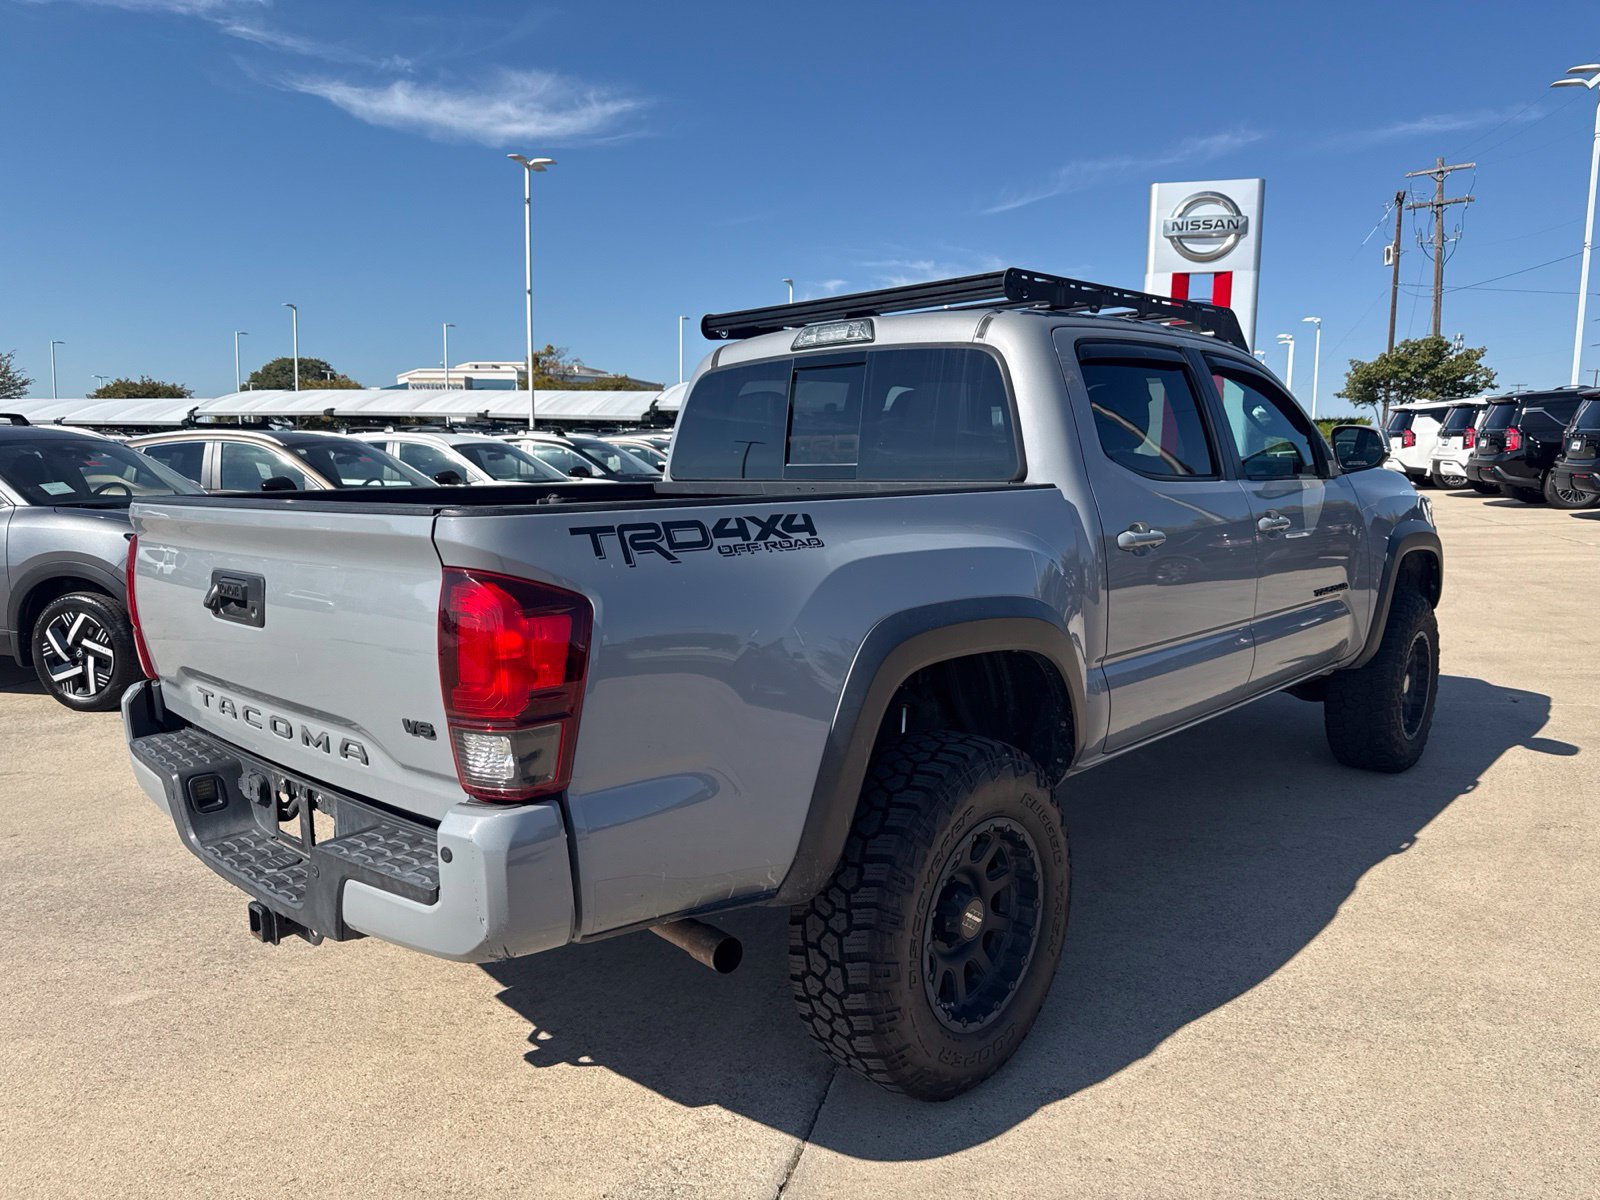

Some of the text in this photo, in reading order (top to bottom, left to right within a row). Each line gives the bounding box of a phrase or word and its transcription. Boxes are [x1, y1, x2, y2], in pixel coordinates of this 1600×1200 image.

[1171, 219, 1240, 232] NISSAN
[568, 513, 818, 568] TRD 4X4
[717, 537, 825, 557] OFF ROAD
[196, 685, 370, 767] TACOMA
[402, 717, 438, 741] V6
[1020, 792, 1063, 867] RUGGED
[937, 1021, 1017, 1068] COOPER
